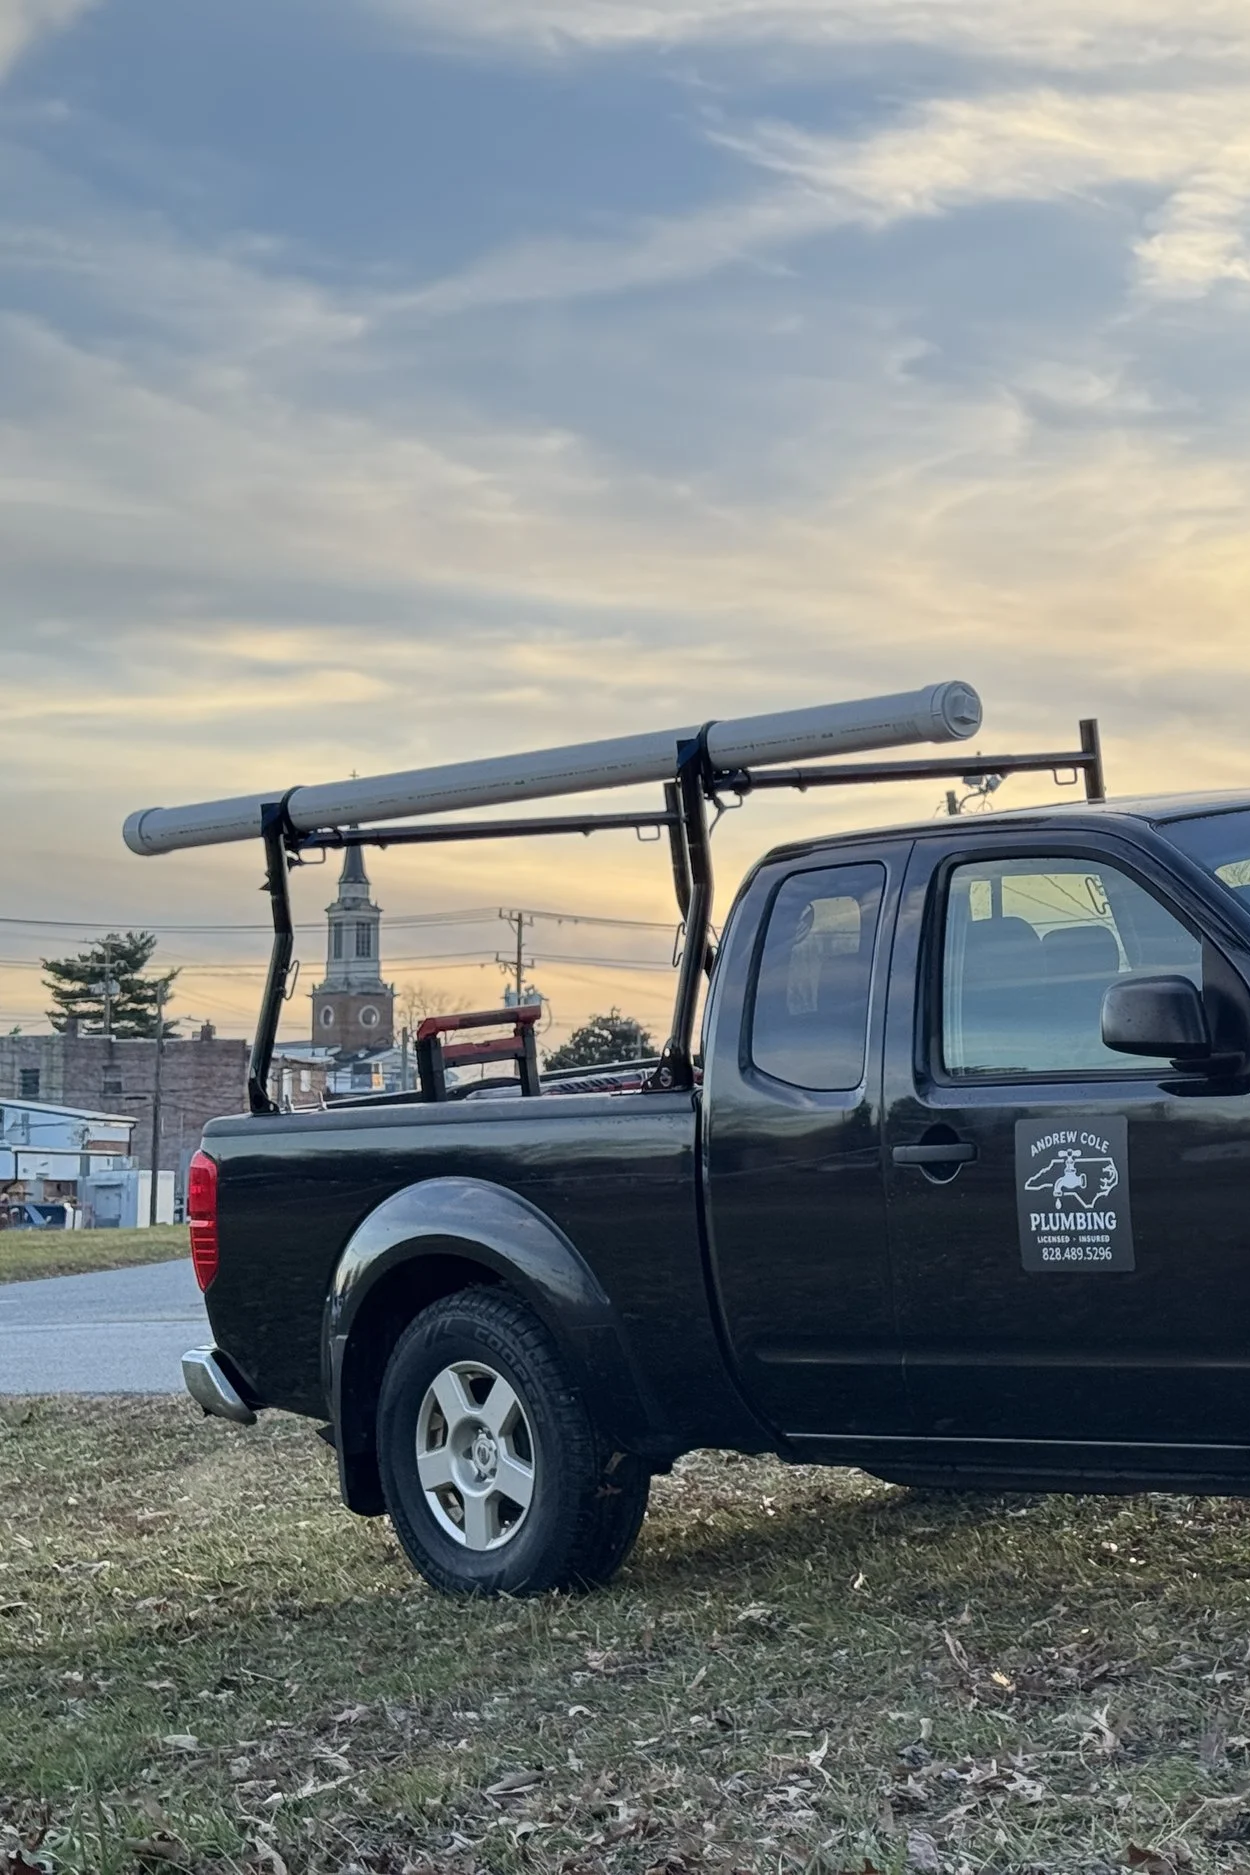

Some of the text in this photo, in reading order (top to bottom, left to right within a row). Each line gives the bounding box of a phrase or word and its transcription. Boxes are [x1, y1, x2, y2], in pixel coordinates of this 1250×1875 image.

[1030, 1130, 1110, 1157] ANDREW COLE
[1030, 1211, 1117, 1231] PLUMBING
[1037, 1234, 1110, 1244] LICENSED INSURED
[1042, 1247, 1112, 1261] 828.489.5296
